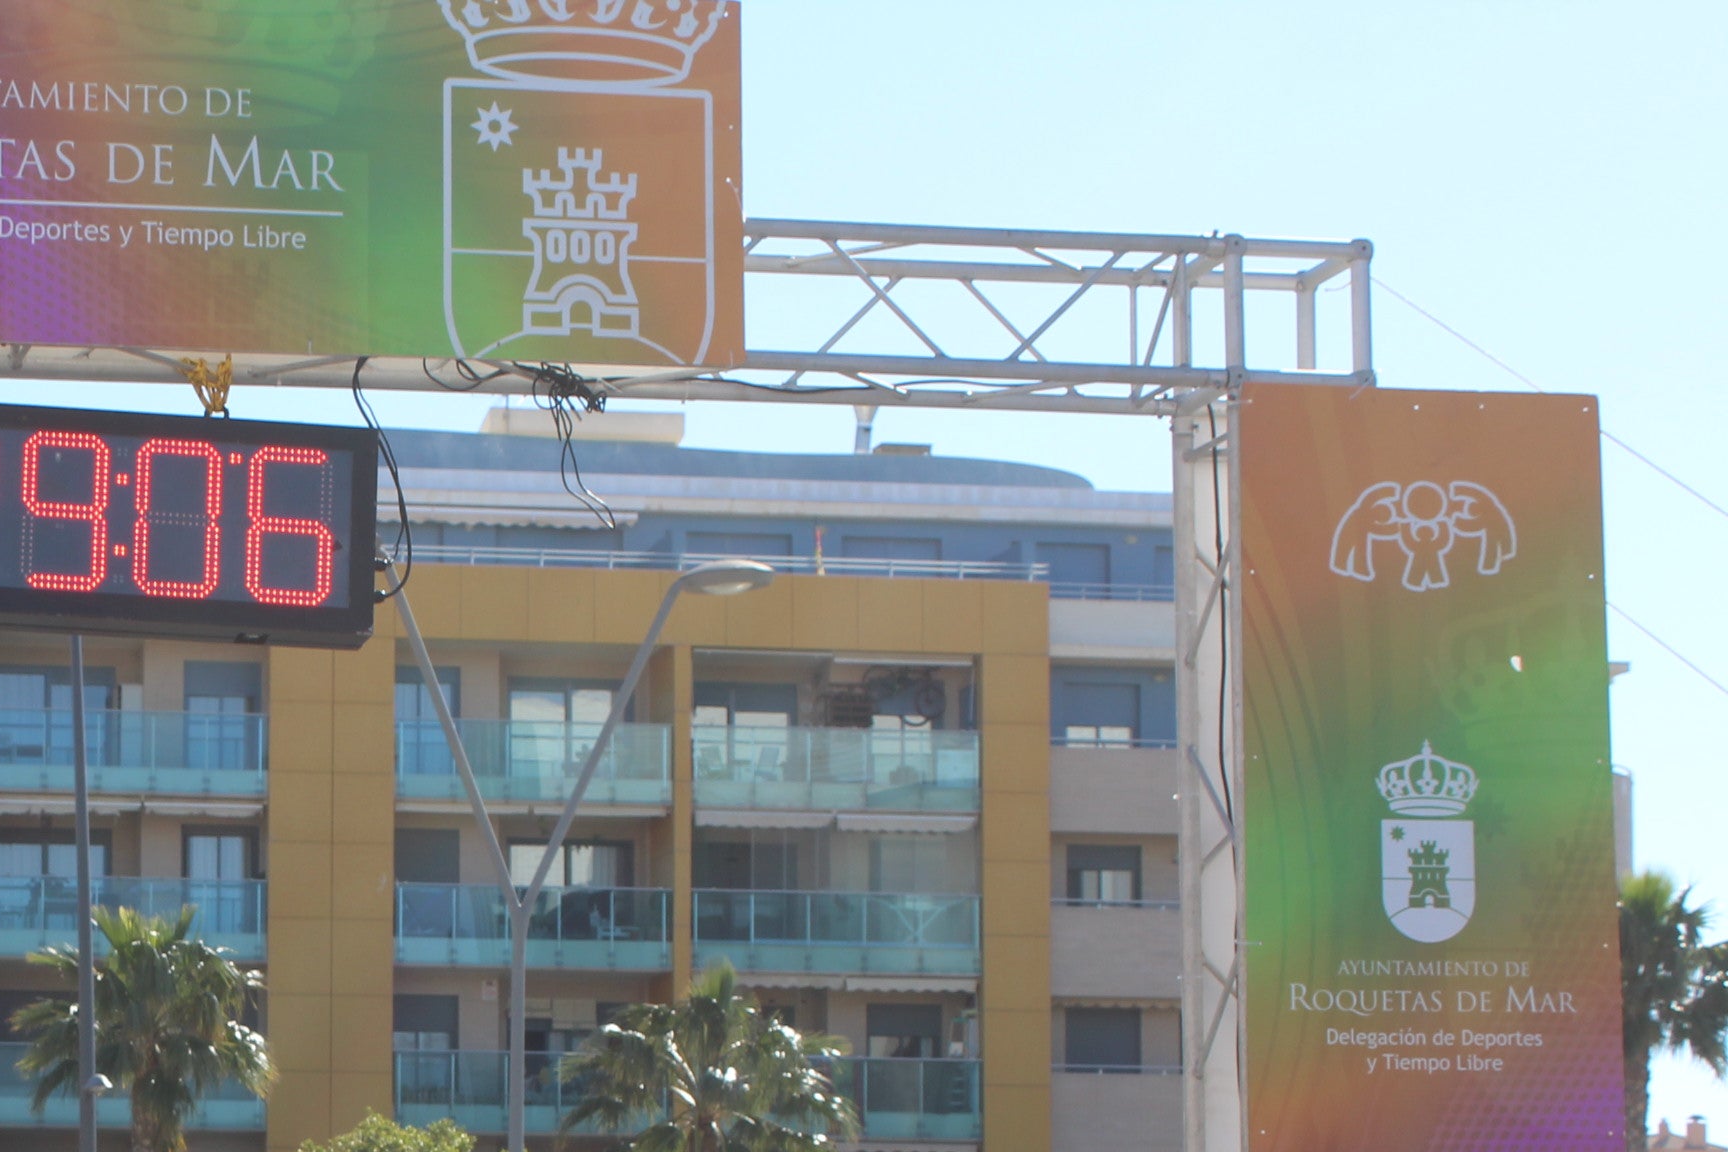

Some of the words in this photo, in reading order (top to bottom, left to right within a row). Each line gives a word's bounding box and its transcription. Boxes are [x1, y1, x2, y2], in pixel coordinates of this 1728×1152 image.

[203, 87, 253, 118] DE
[106, 142, 175, 185] DE
[202, 133, 345, 192] MAR
[119, 224, 133, 247] y
[141, 220, 235, 249] Tiempo
[242, 224, 307, 250] Libre
[1337, 959, 1499, 977] AYUNTAMIENTO
[1504, 961, 1530, 978] DE
[1289, 983, 1443, 1016] ROQUETAS
[1457, 991, 1492, 1013] DE
[1506, 985, 1578, 1014] MAR
[1326, 1028, 1426, 1050] Delegación
[1432, 1030, 1455, 1047] de
[1461, 1029, 1544, 1051] Deportes
[1367, 1057, 1377, 1074] y
[1383, 1053, 1451, 1075] Tiempo
[1456, 1054, 1504, 1072] Libre
